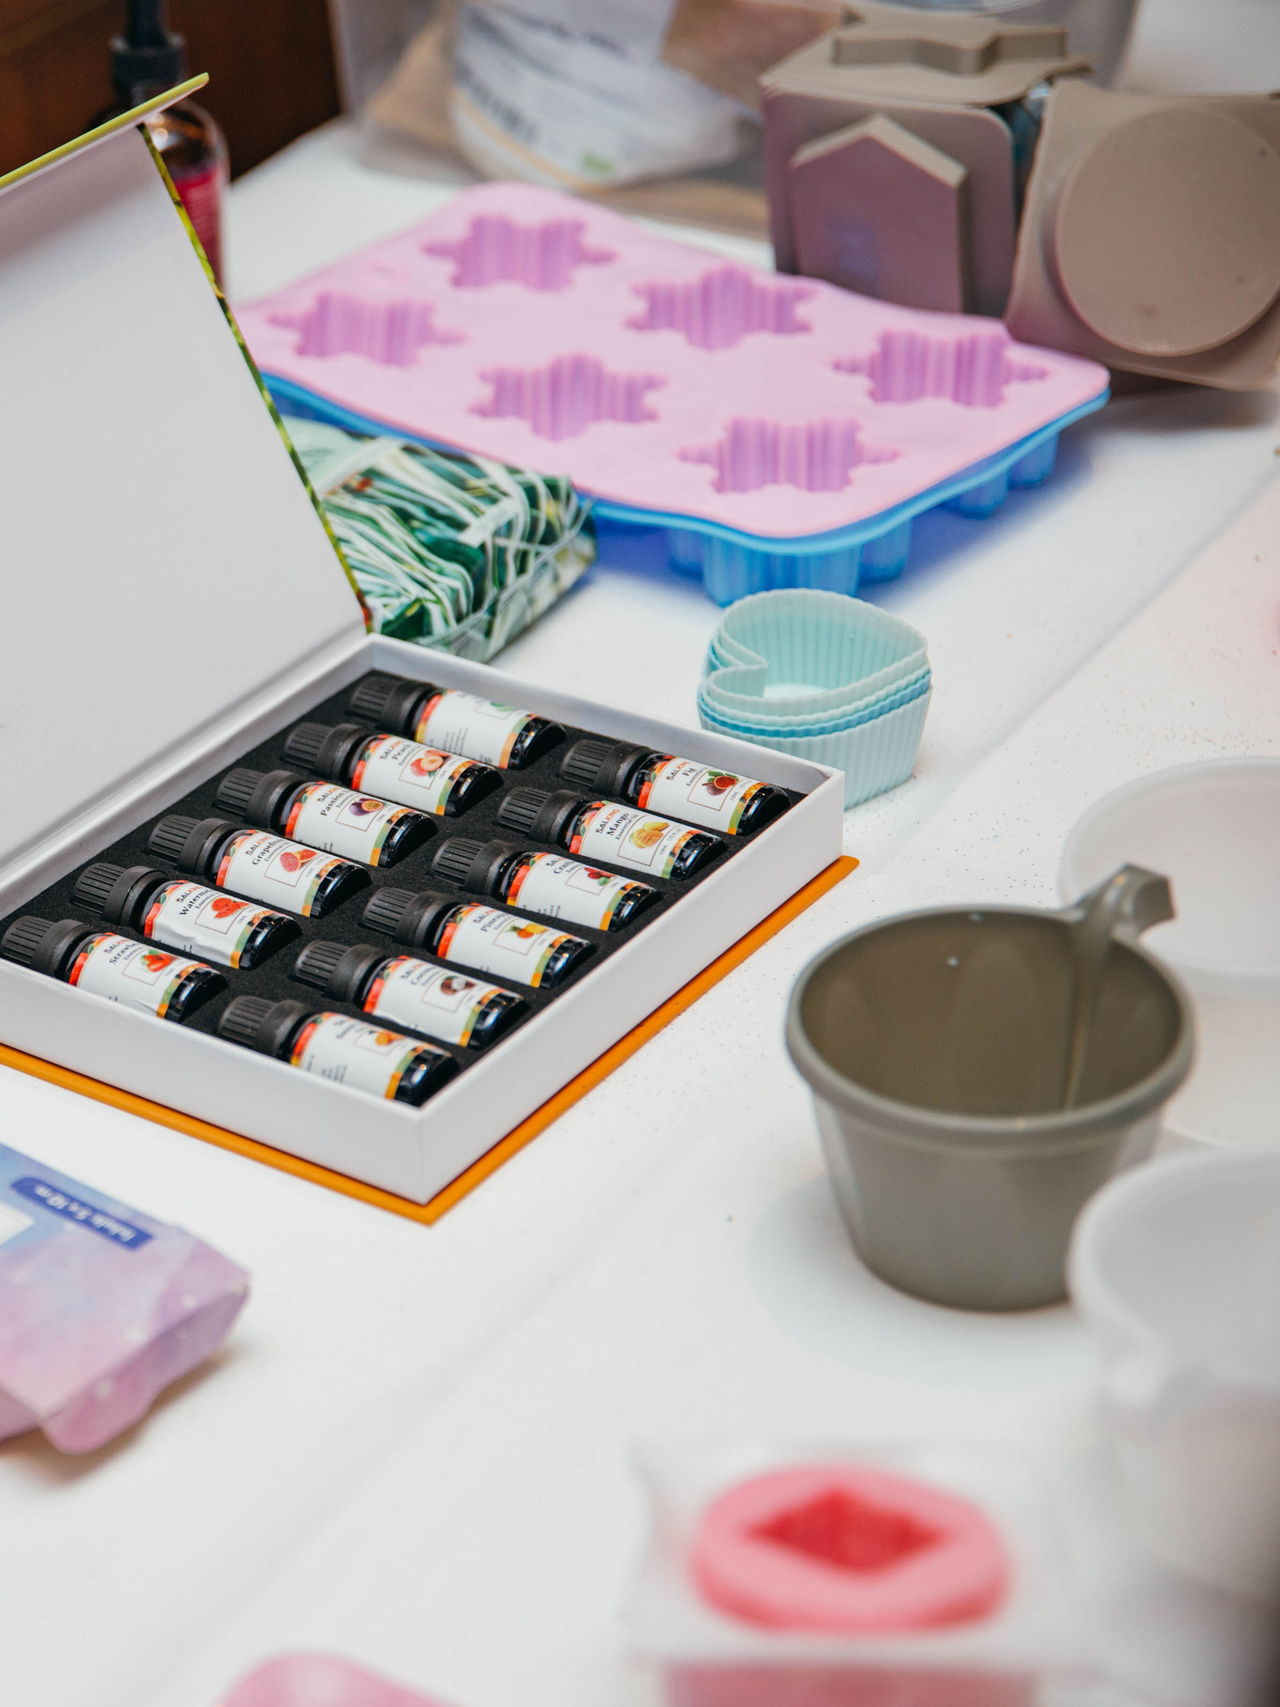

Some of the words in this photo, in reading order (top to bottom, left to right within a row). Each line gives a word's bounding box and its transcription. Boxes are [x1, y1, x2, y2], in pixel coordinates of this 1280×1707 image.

[392, 744, 411, 760] Peach
[683, 767, 697, 777] Fig
[320, 791, 345, 816] Passion
[596, 809, 620, 834] SALKING
[607, 813, 629, 836] Mango
[615, 816, 633, 840] Essential
